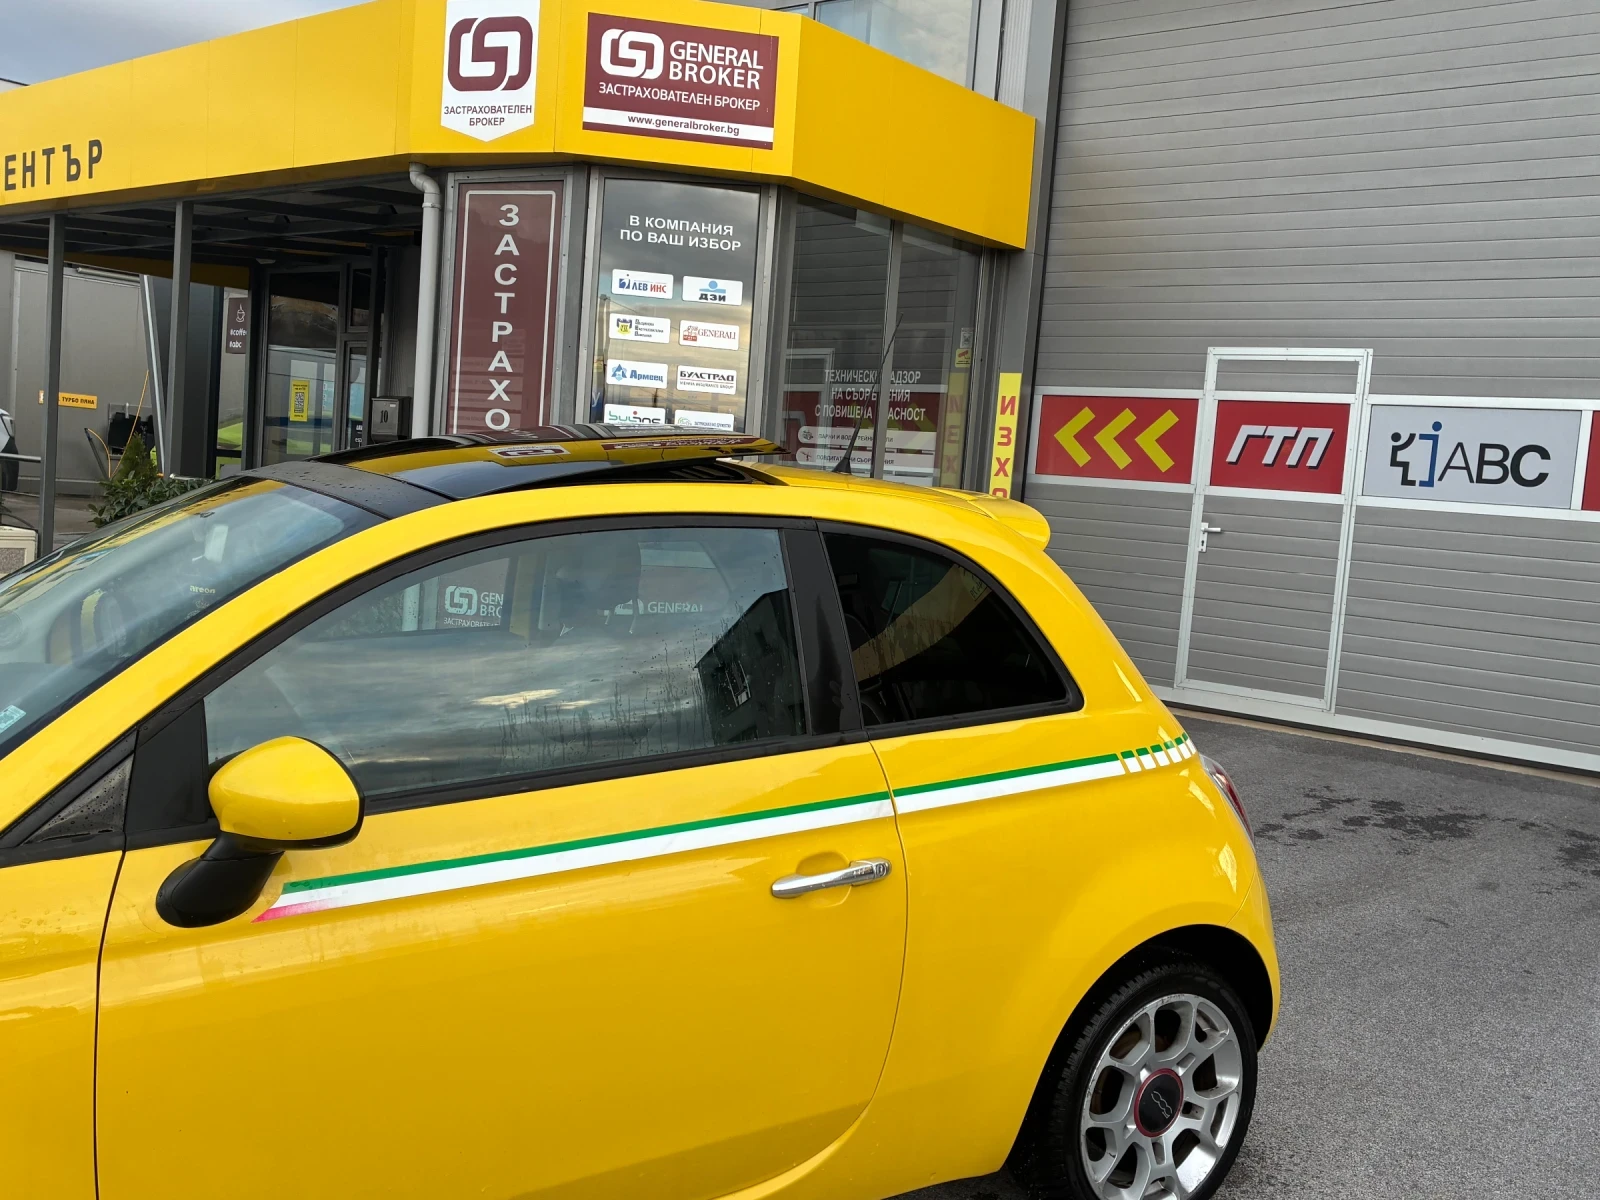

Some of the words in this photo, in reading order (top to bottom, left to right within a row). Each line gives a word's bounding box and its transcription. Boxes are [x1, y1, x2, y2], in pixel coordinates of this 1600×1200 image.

[669, 40, 763, 70] GENERAL
[669, 61, 760, 90] BROKER
[599, 82, 712, 105] ЗАСТРАХОВАТЕЛЕН
[714, 95, 761, 112] БРОКЕР
[443, 104, 532, 115] ЗАСТРАХОВАТЕЛЕН
[469, 116, 505, 126] БРОКЕР
[627, 114, 740, 137] www.generalbroker.bg
[5, 139, 103, 191] ЕНТЪР
[629, 215, 640, 226] В
[645, 216, 734, 237] КОМПАНИЯ
[620, 229, 643, 242] ПО
[647, 231, 684, 246] ВАШ
[688, 236, 742, 252] ИЗБОР
[631, 282, 648, 292] ЛЕВ
[650, 283, 667, 294] ИНС
[698, 292, 727, 303] ДЗИ
[485, 204, 520, 430] ЗАСТРАХО
[698, 328, 736, 340] GENERALI
[629, 369, 664, 383] Армеец
[890, 370, 921, 385] АДЗОР
[1226, 424, 1334, 470] ГТП
[1437, 442, 1551, 488] ABC
